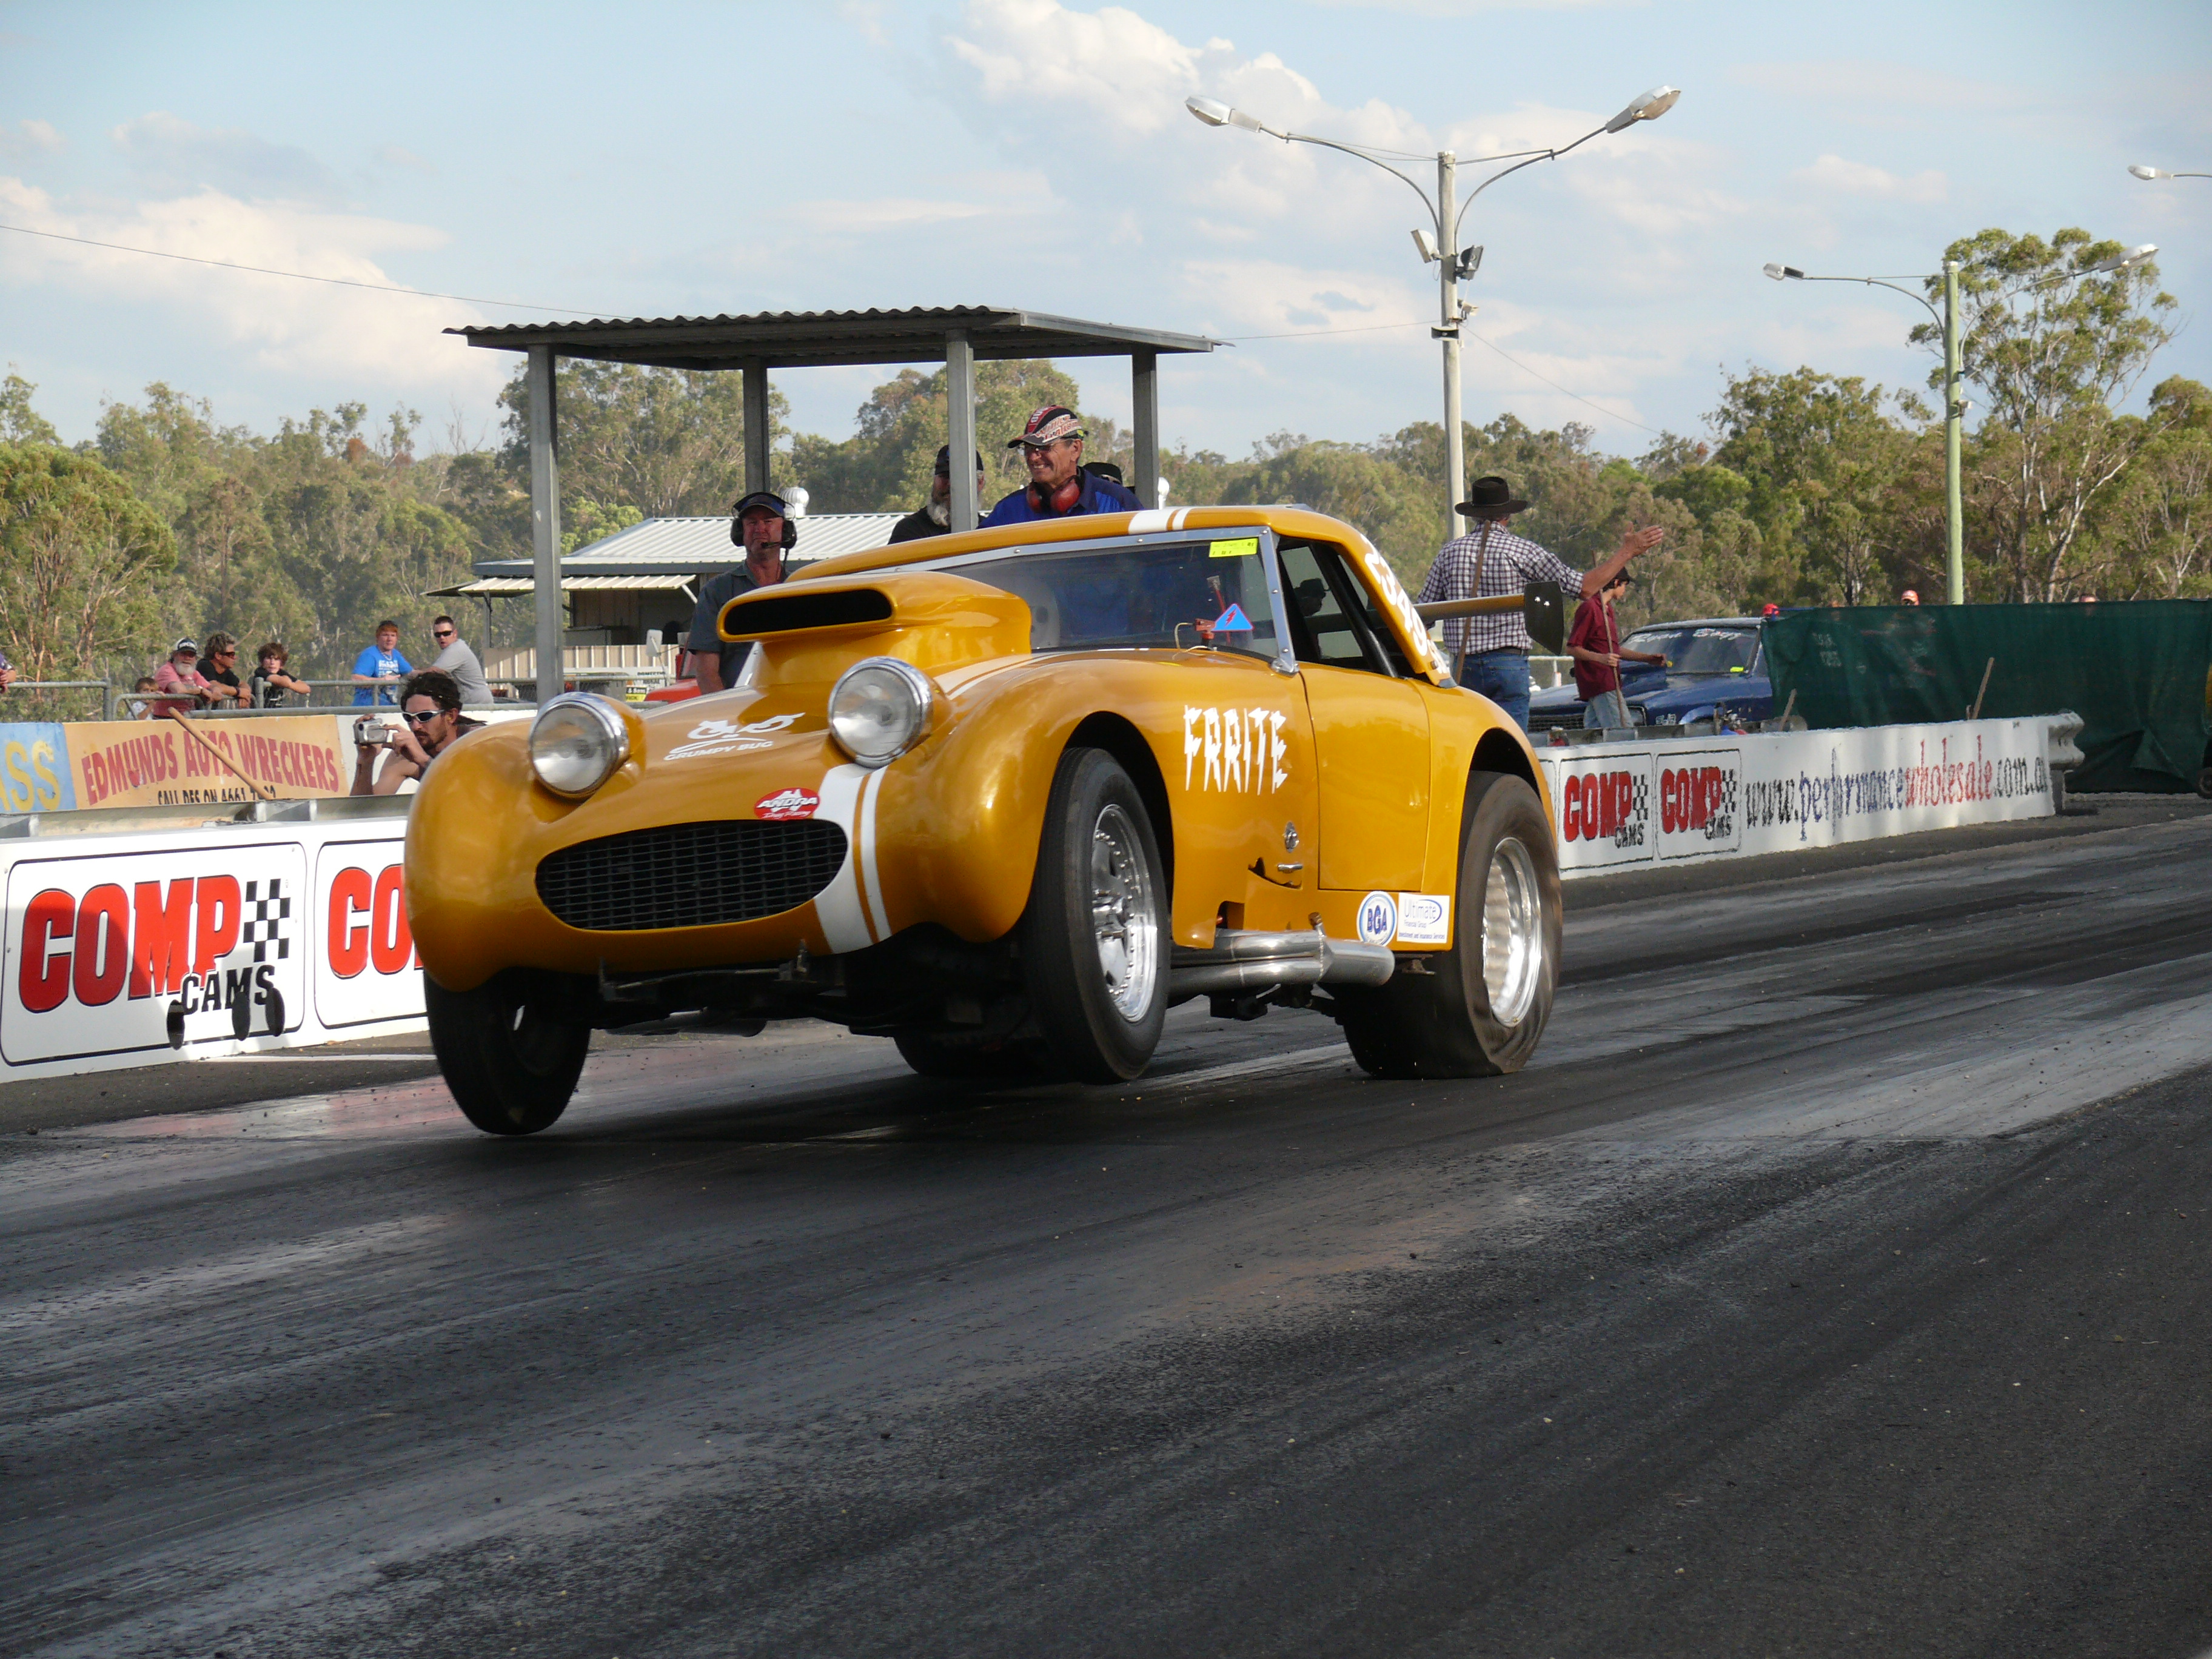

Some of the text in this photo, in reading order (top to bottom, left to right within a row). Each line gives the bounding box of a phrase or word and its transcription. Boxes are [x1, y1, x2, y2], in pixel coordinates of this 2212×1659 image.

[81, 730, 339, 805] EDMUNDS AUTO WRECKERS
[663, 741, 774, 760] GRUMPY BUG
[756, 797, 818, 808] ANDRA
[1564, 770, 1632, 842] COMP
[1660, 766, 1721, 834] COMP
[1615, 822, 1644, 848] CAMS
[19, 874, 241, 1013] COMP
[328, 863, 425, 980] CO
[1367, 905, 1387, 934] BGA
[181, 964, 276, 1015] CAMS
